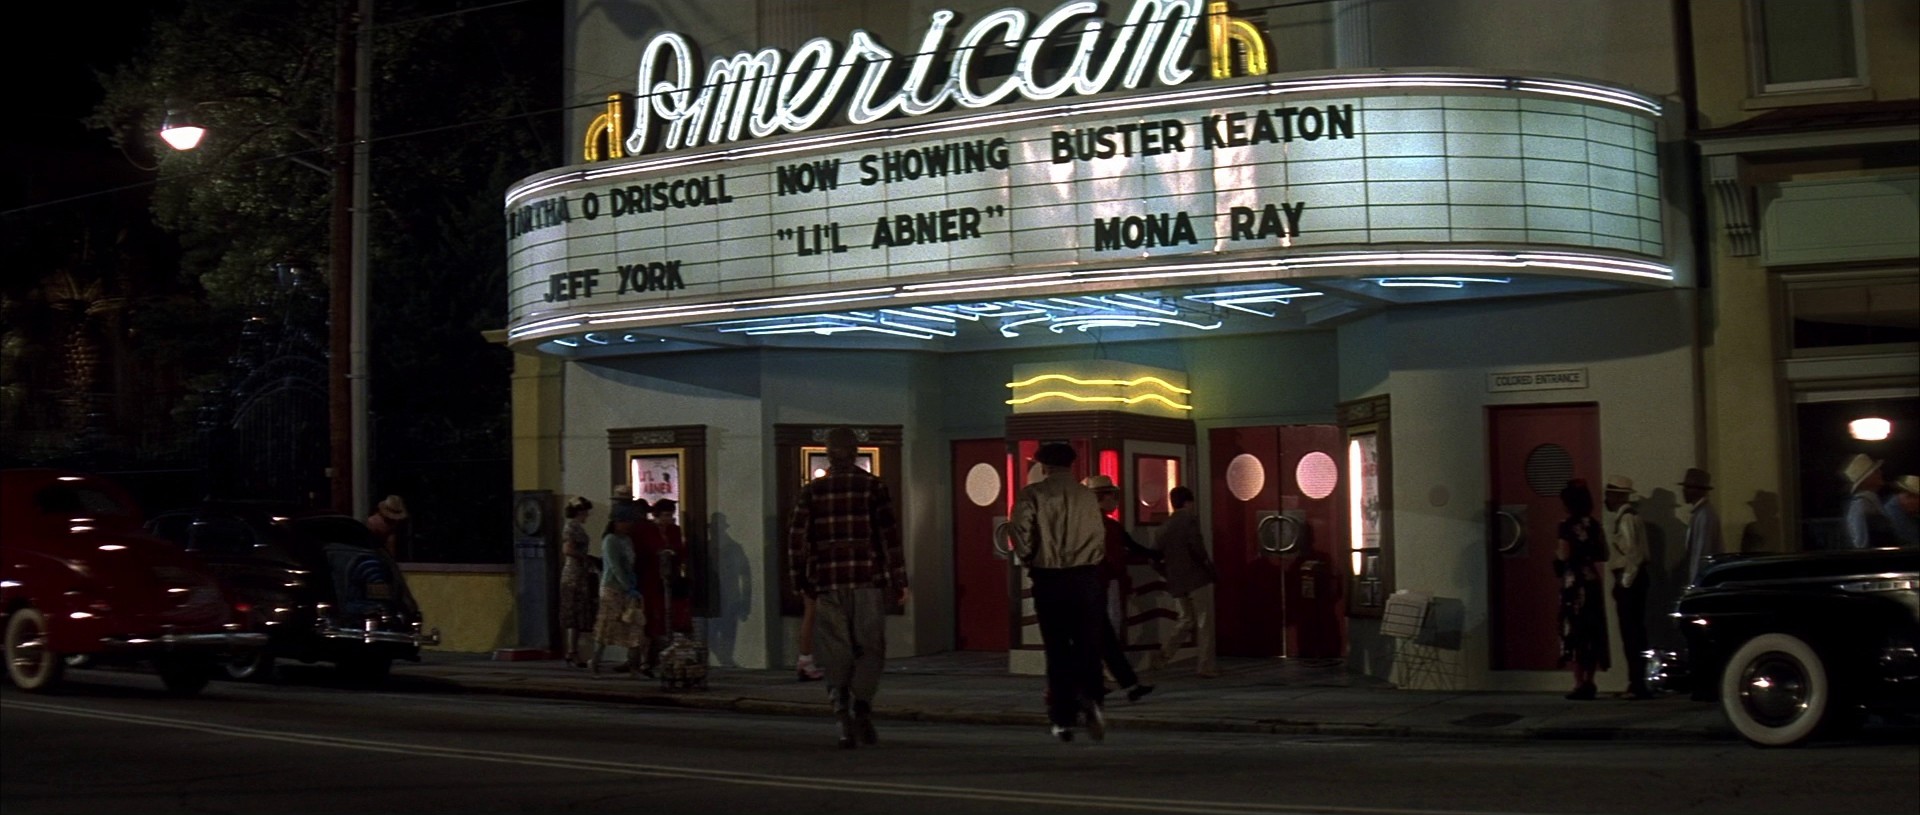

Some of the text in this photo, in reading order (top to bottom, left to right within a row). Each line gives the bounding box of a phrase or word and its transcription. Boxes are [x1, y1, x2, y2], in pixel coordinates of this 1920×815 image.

[626, 0, 1209, 154] American
[1051, 104, 1354, 164] BUSTER KEATON
[777, 137, 1010, 196] NOW SHOWING
[582, 192, 599, 220] O
[610, 174, 733, 218] DRISCOLL
[871, 205, 1004, 249] ABNER"
[1094, 202, 1305, 251] MONA RAY
[544, 260, 686, 302] JEFF YORK
[1495, 373, 1580, 387] COLORED ENTRANCE
